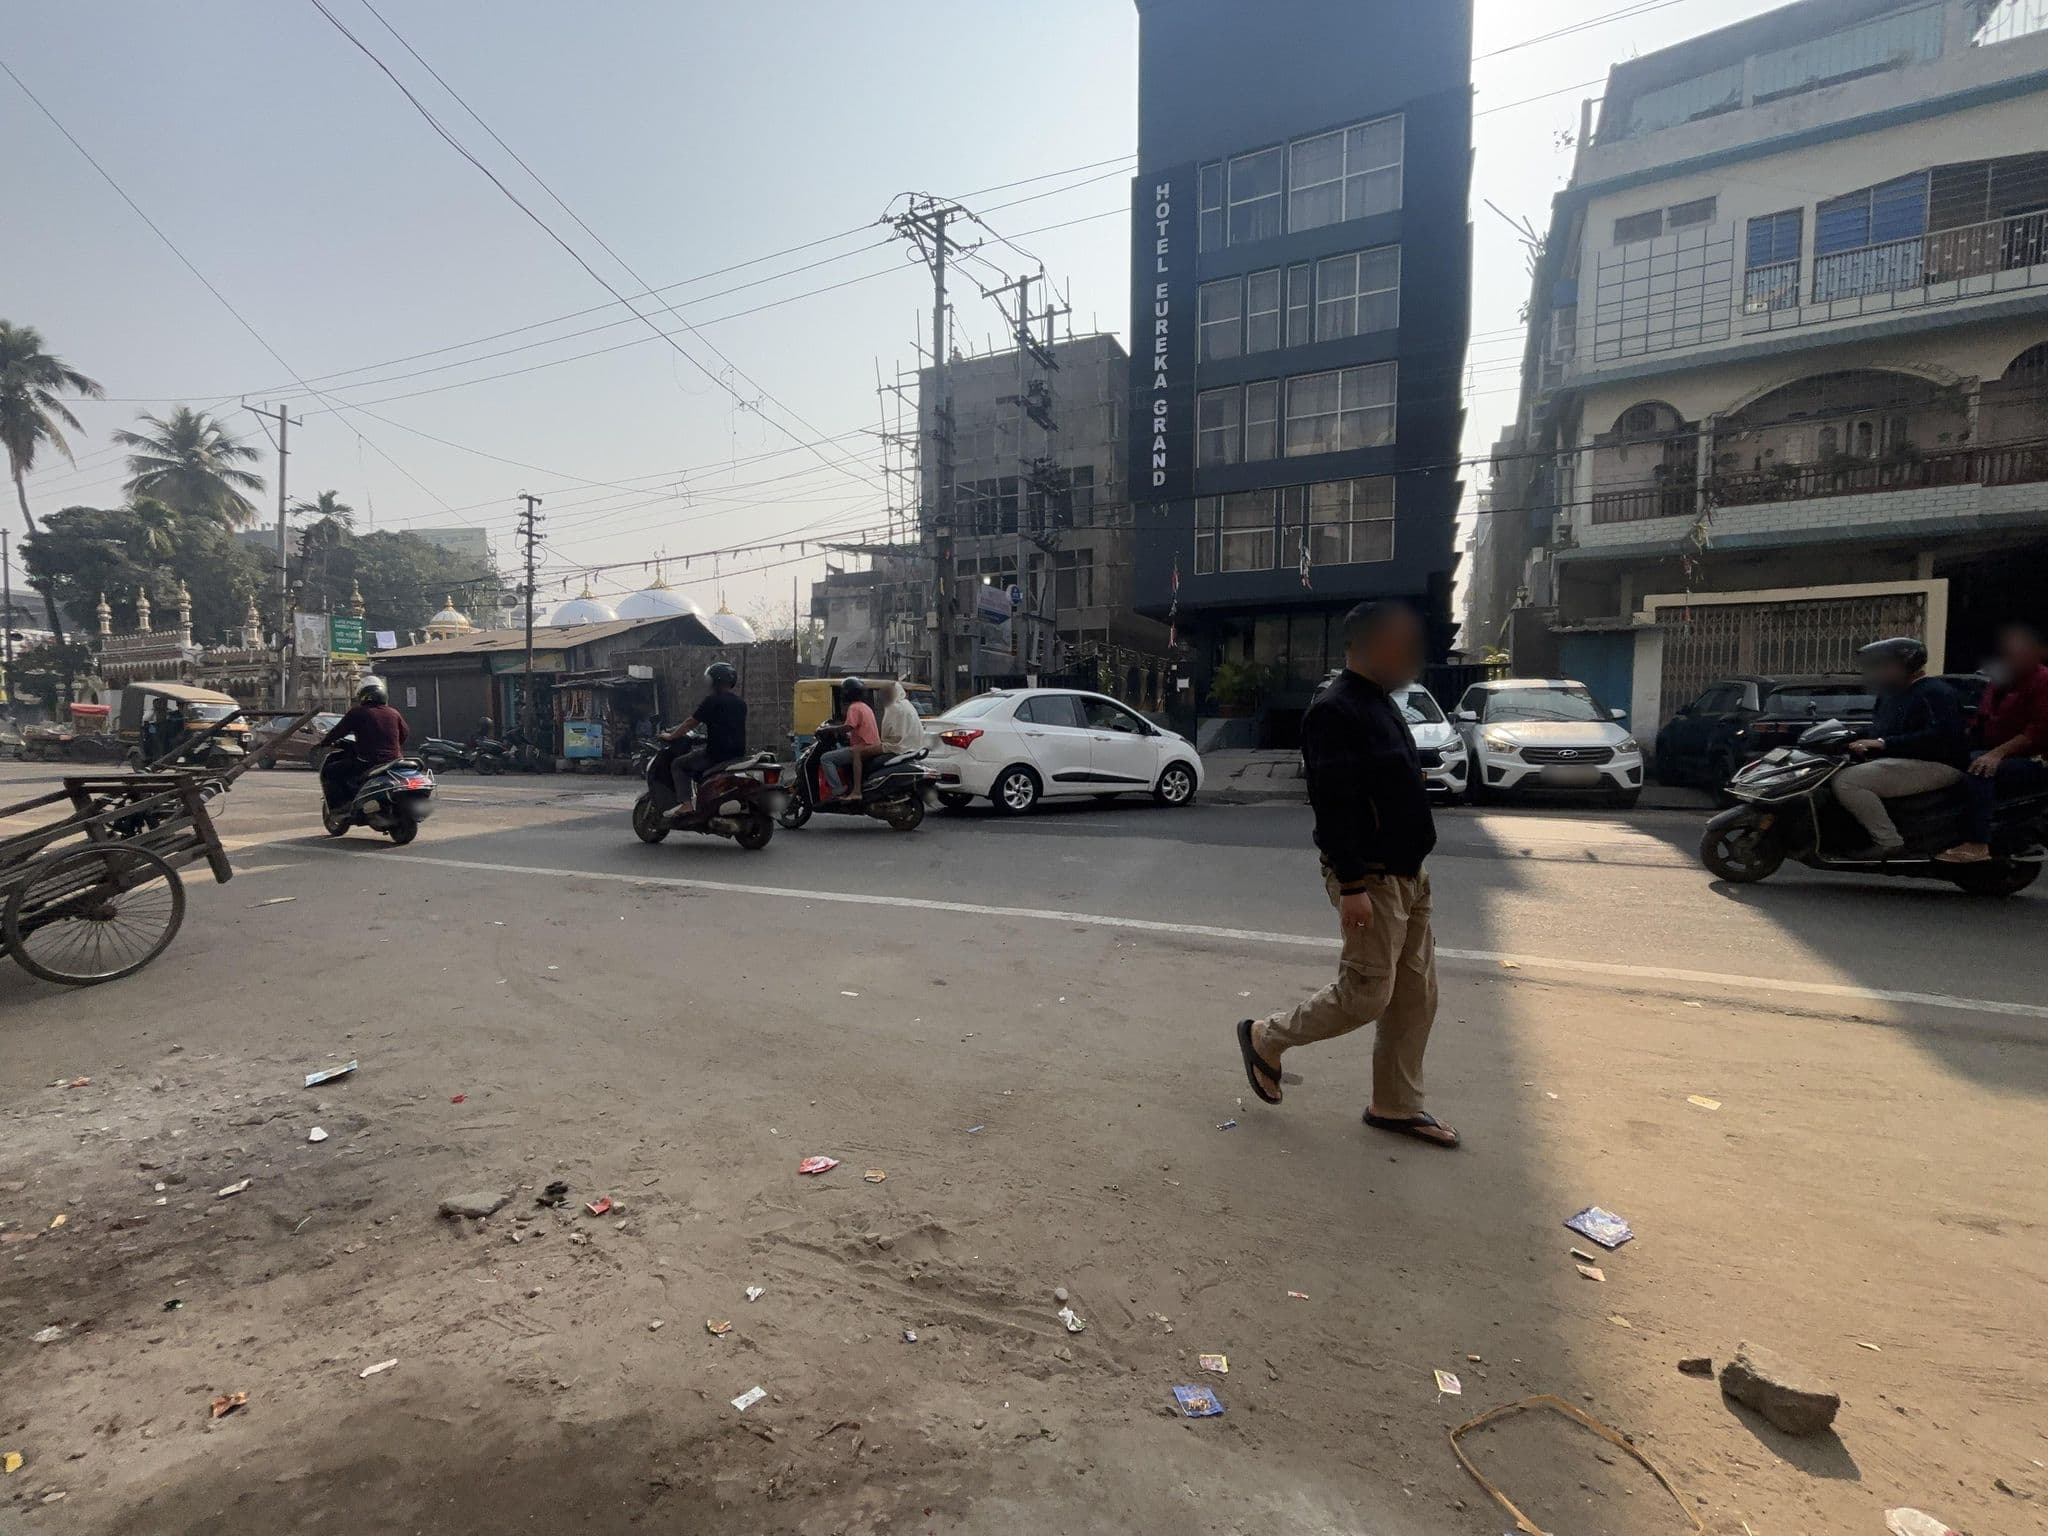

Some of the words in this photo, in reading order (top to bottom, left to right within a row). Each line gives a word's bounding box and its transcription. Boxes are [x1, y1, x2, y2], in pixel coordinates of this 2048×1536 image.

[1156, 183, 1169, 272] HOTEL
[1154, 283, 1168, 389] EUREKA
[1153, 400, 1168, 486] GRAND
